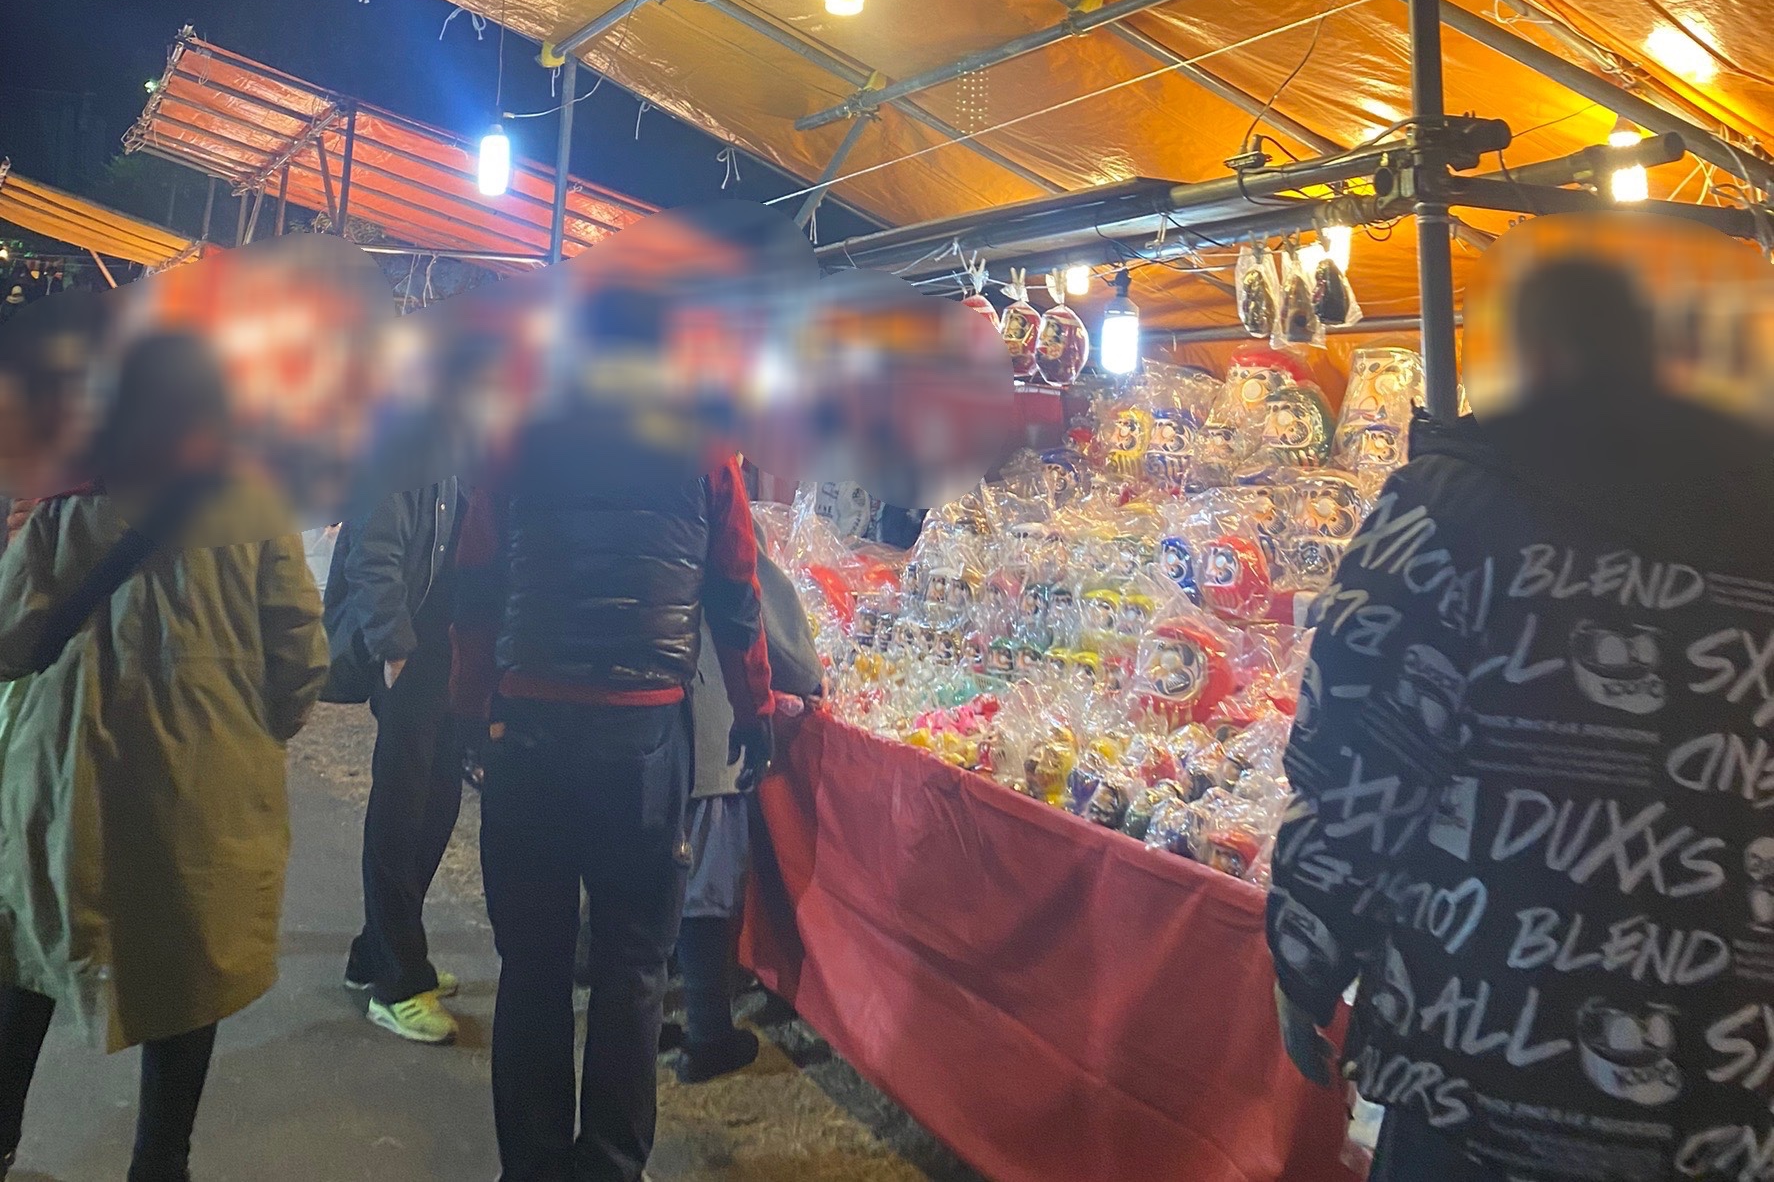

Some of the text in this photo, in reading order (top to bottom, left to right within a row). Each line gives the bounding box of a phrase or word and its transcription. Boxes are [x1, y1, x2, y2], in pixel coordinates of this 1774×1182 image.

[1508, 543, 1705, 609] BLEND
[1491, 788, 1727, 898] DUXXS
[1507, 906, 1731, 985] BLEND
[1420, 976, 1574, 1068] ALL
